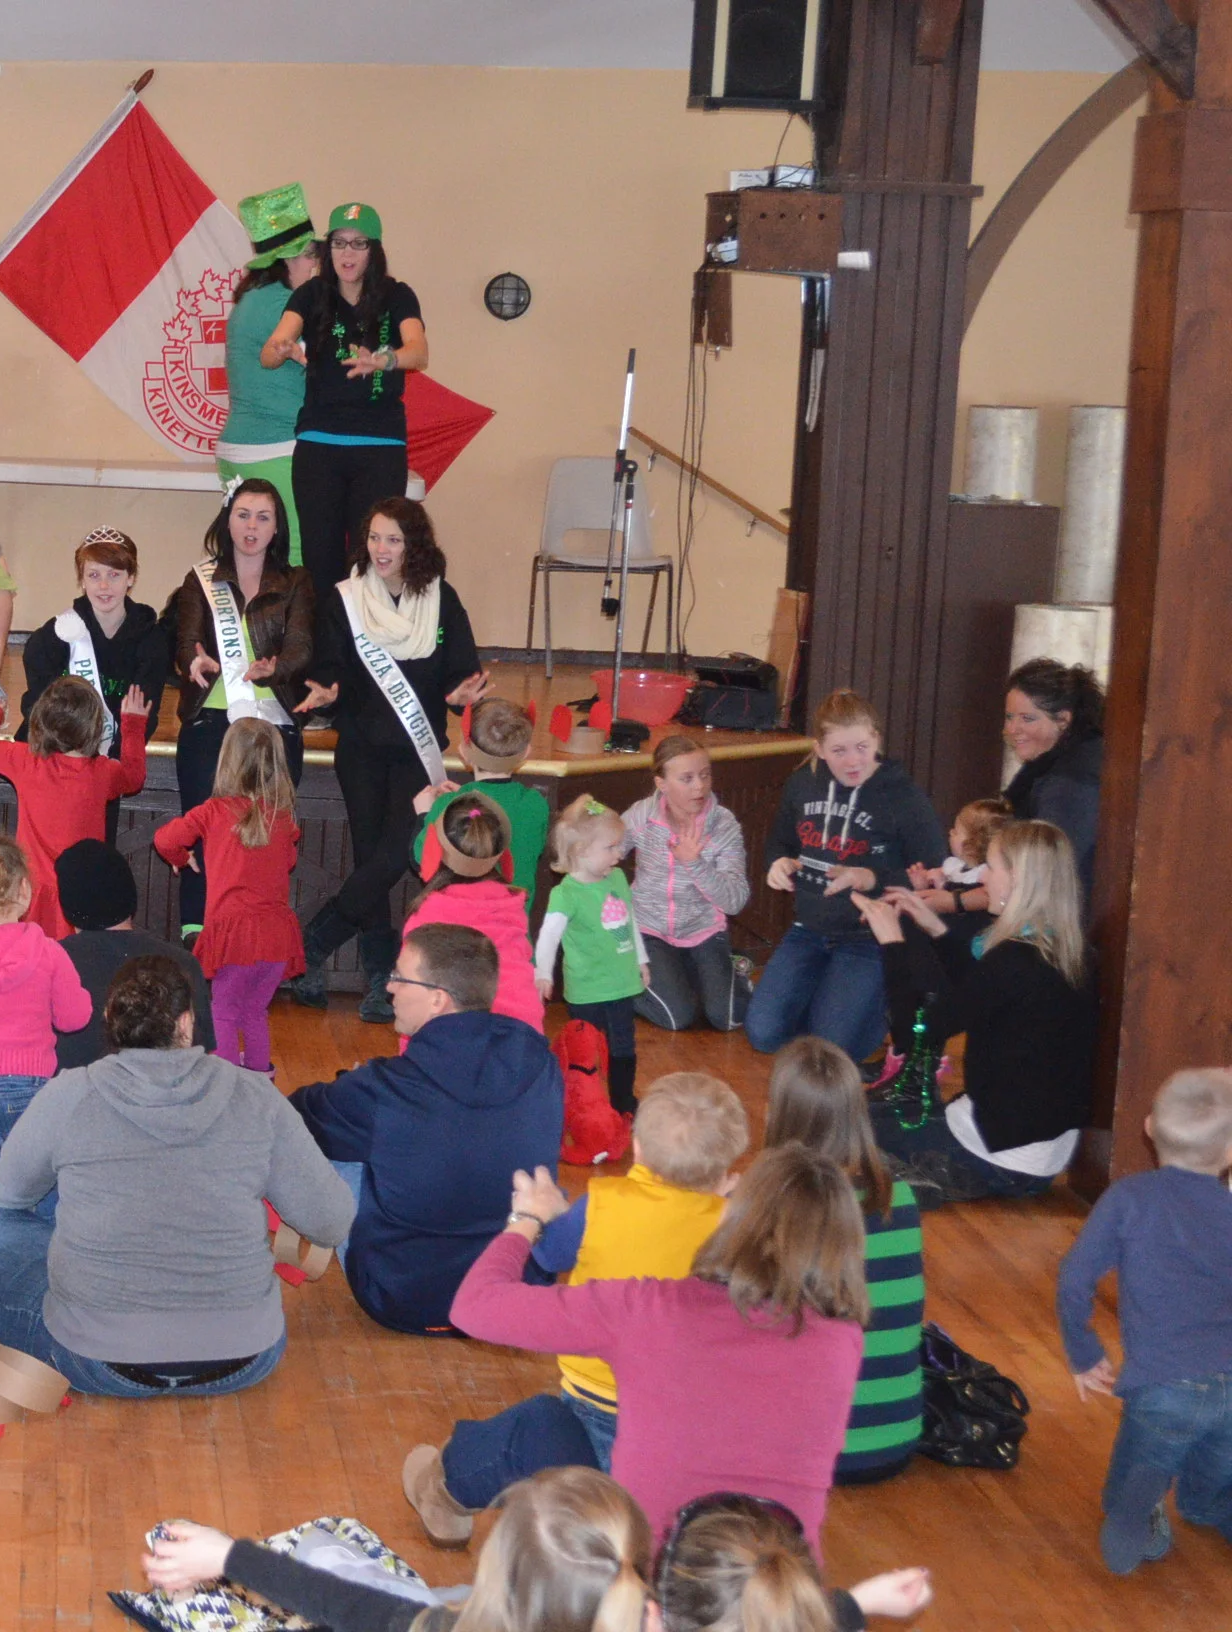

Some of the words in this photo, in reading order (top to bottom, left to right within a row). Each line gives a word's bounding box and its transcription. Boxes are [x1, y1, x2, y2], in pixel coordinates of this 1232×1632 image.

[148, 387, 217, 451] KINETTE
[169, 359, 229, 427] KINSME
[211, 588, 242, 658] HORTONS
[355, 633, 393, 678] PIZZA
[387, 680, 433, 749] DELIGHT
[798, 821, 869, 860] Gaage
